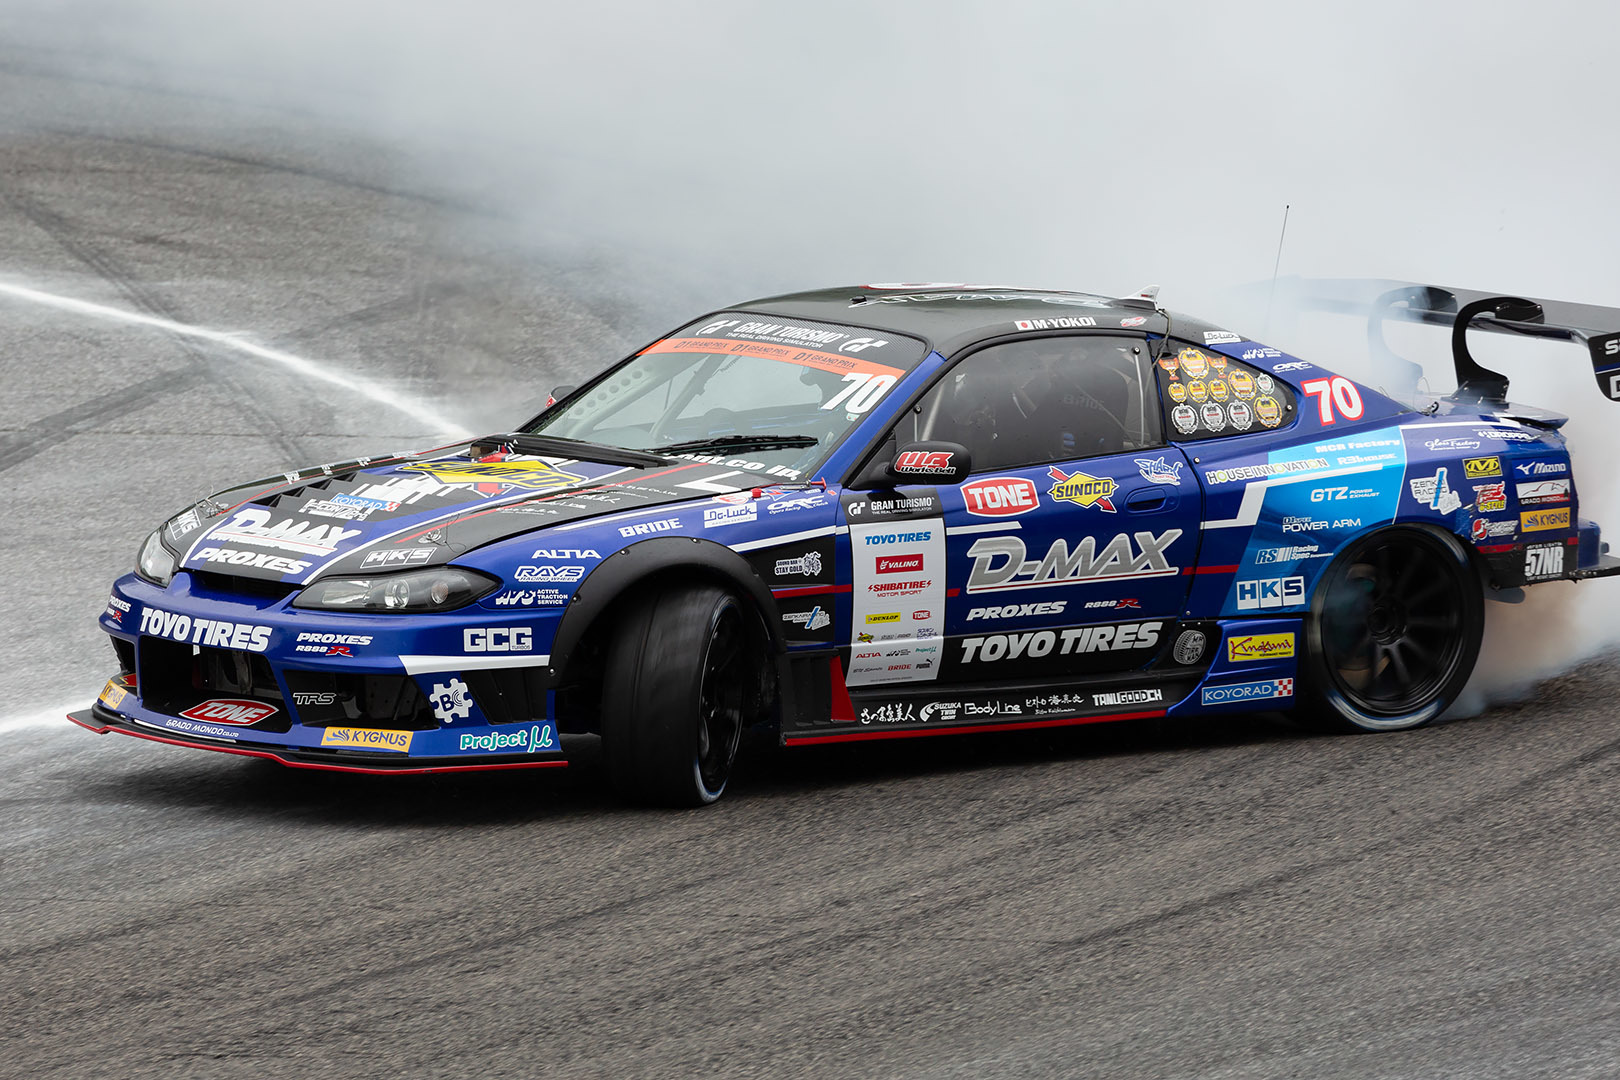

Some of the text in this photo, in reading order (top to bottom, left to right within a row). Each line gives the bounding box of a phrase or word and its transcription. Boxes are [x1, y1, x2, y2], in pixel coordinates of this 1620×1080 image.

[734, 322, 846, 343] GRAN TURISMO
[730, 344, 791, 356] D1 GRAND PRIX
[792, 352, 857, 368] D1 GRAND PRIX
[818, 372, 899, 414] 70
[1301, 375, 1364, 426] 70
[1315, 439, 1400, 453] MCR Factory
[968, 483, 1033, 510] TONE
[1056, 481, 1111, 498] SUNOCO
[1311, 487, 1349, 502] GTZ
[333, 495, 384, 510] KOYORAD
[767, 495, 825, 510] ORC
[871, 497, 932, 510] GRAN TURISMO
[213, 508, 362, 551] D-MAX
[618, 518, 683, 538] BRIDE
[1283, 520, 1329, 532] POWER
[1332, 518, 1361, 529] ARM
[865, 531, 931, 545] TOYO TIRES
[191, 547, 312, 575] PROXES
[364, 549, 432, 564] HKS
[886, 560, 919, 570] VALINO
[966, 529, 1183, 590] D-MAX
[1524, 546, 1564, 577] 57NR
[516, 567, 584, 578] RAYS
[872, 581, 928, 592] SHIBATIRE
[1237, 578, 1304, 604] HKS
[966, 601, 1068, 621] PROXES
[139, 606, 273, 652] TOYO TIRES
[296, 633, 373, 646] PROXES
[463, 627, 532, 652] GCG
[961, 621, 1163, 663] TOYO TIRES
[292, 692, 337, 705] TRS
[1205, 684, 1272, 701] KOYORAD
[198, 702, 264, 723] TONE
[166, 719, 192, 731] GRADO
[192, 722, 224, 736] MONDO
[352, 729, 408, 747] KYGNUS
[460, 731, 526, 752] Project
